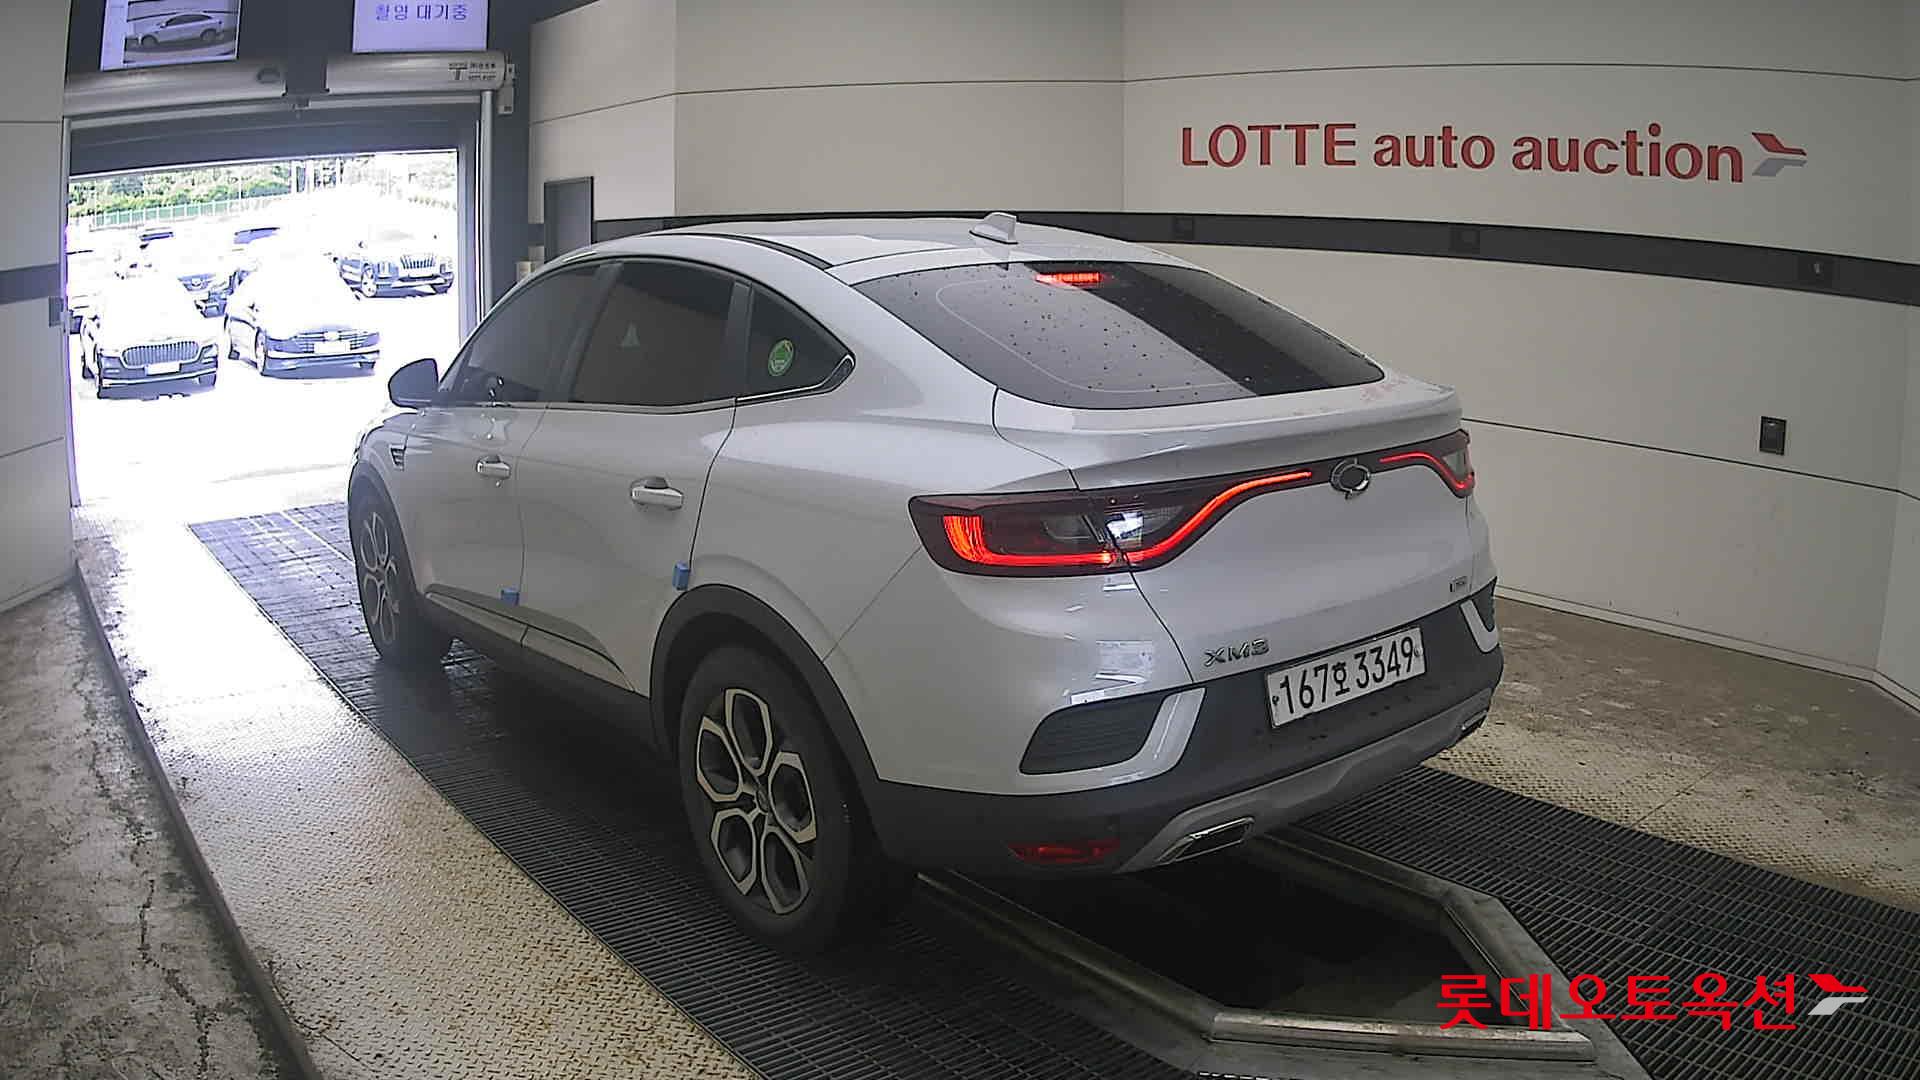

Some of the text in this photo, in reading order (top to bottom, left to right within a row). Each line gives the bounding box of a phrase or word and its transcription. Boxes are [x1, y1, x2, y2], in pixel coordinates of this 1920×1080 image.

[416, 4, 467, 21] 대기중
[1181, 122, 1744, 183] LOTTE auto auction
[1203, 638, 1270, 667] XM3
[1353, 635, 1415, 690] 3349
